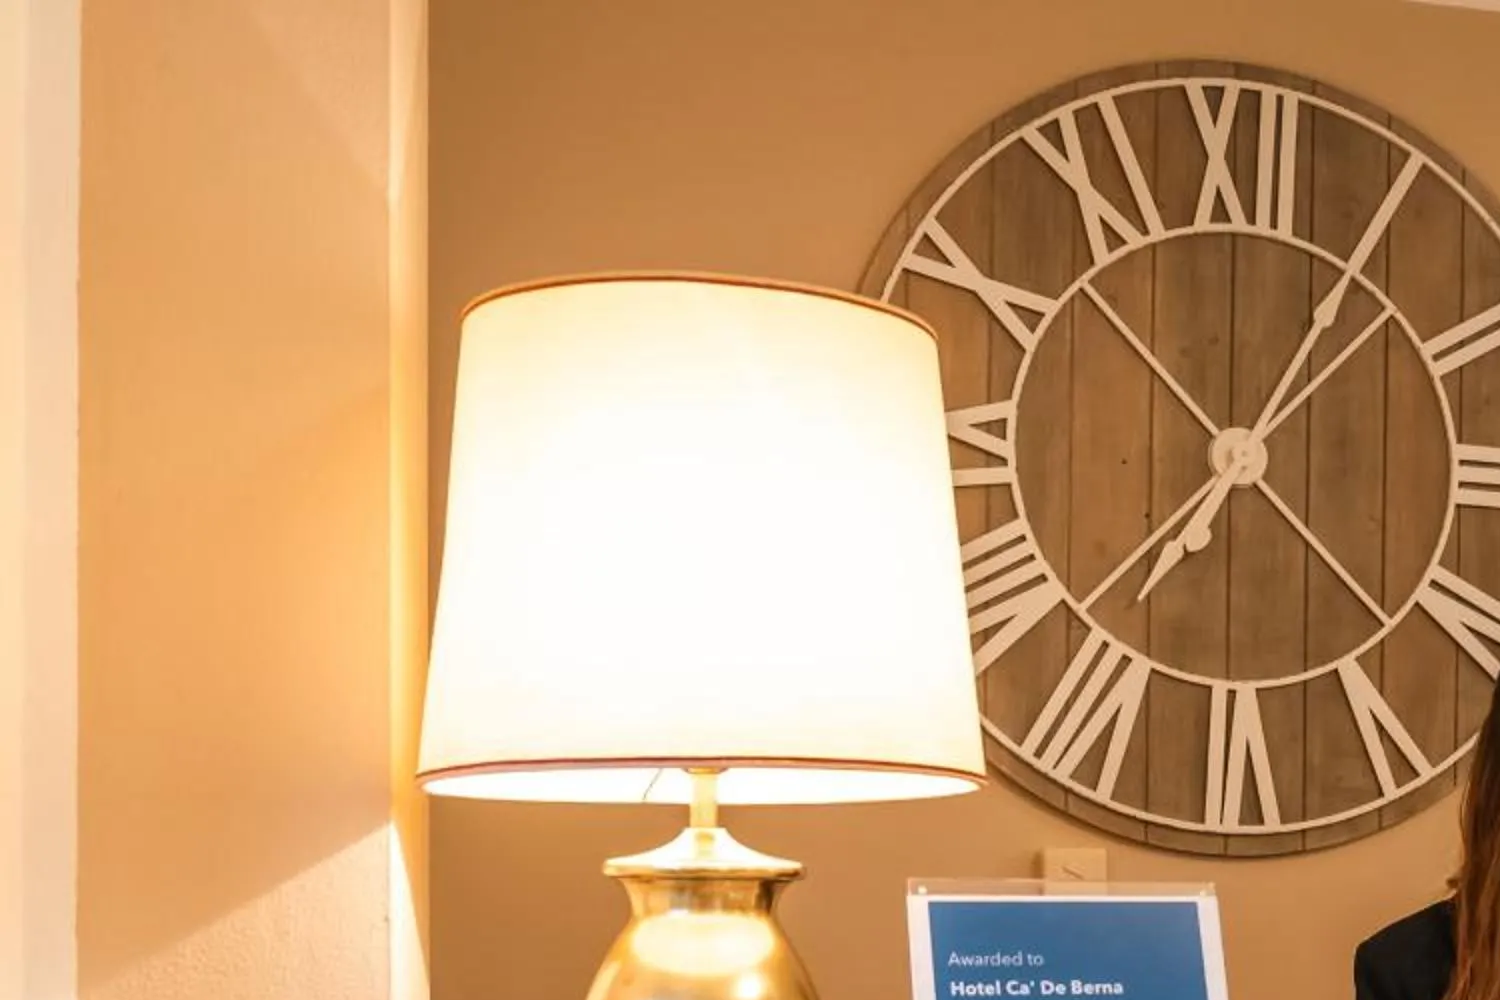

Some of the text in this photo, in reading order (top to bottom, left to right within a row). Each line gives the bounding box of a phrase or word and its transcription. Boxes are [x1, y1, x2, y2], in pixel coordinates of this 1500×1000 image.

[1021, 92, 1166, 266] XI
[1183, 83, 1299, 238] XII
[902, 217, 1060, 351] X
[1021, 631, 1150, 802] VII
[1205, 684, 1281, 828] VI
[1338, 656, 1435, 799] V
[948, 951, 1044, 967] Awarded to
[950, 979, 1124, 997] Hotel Ca' De Berna
